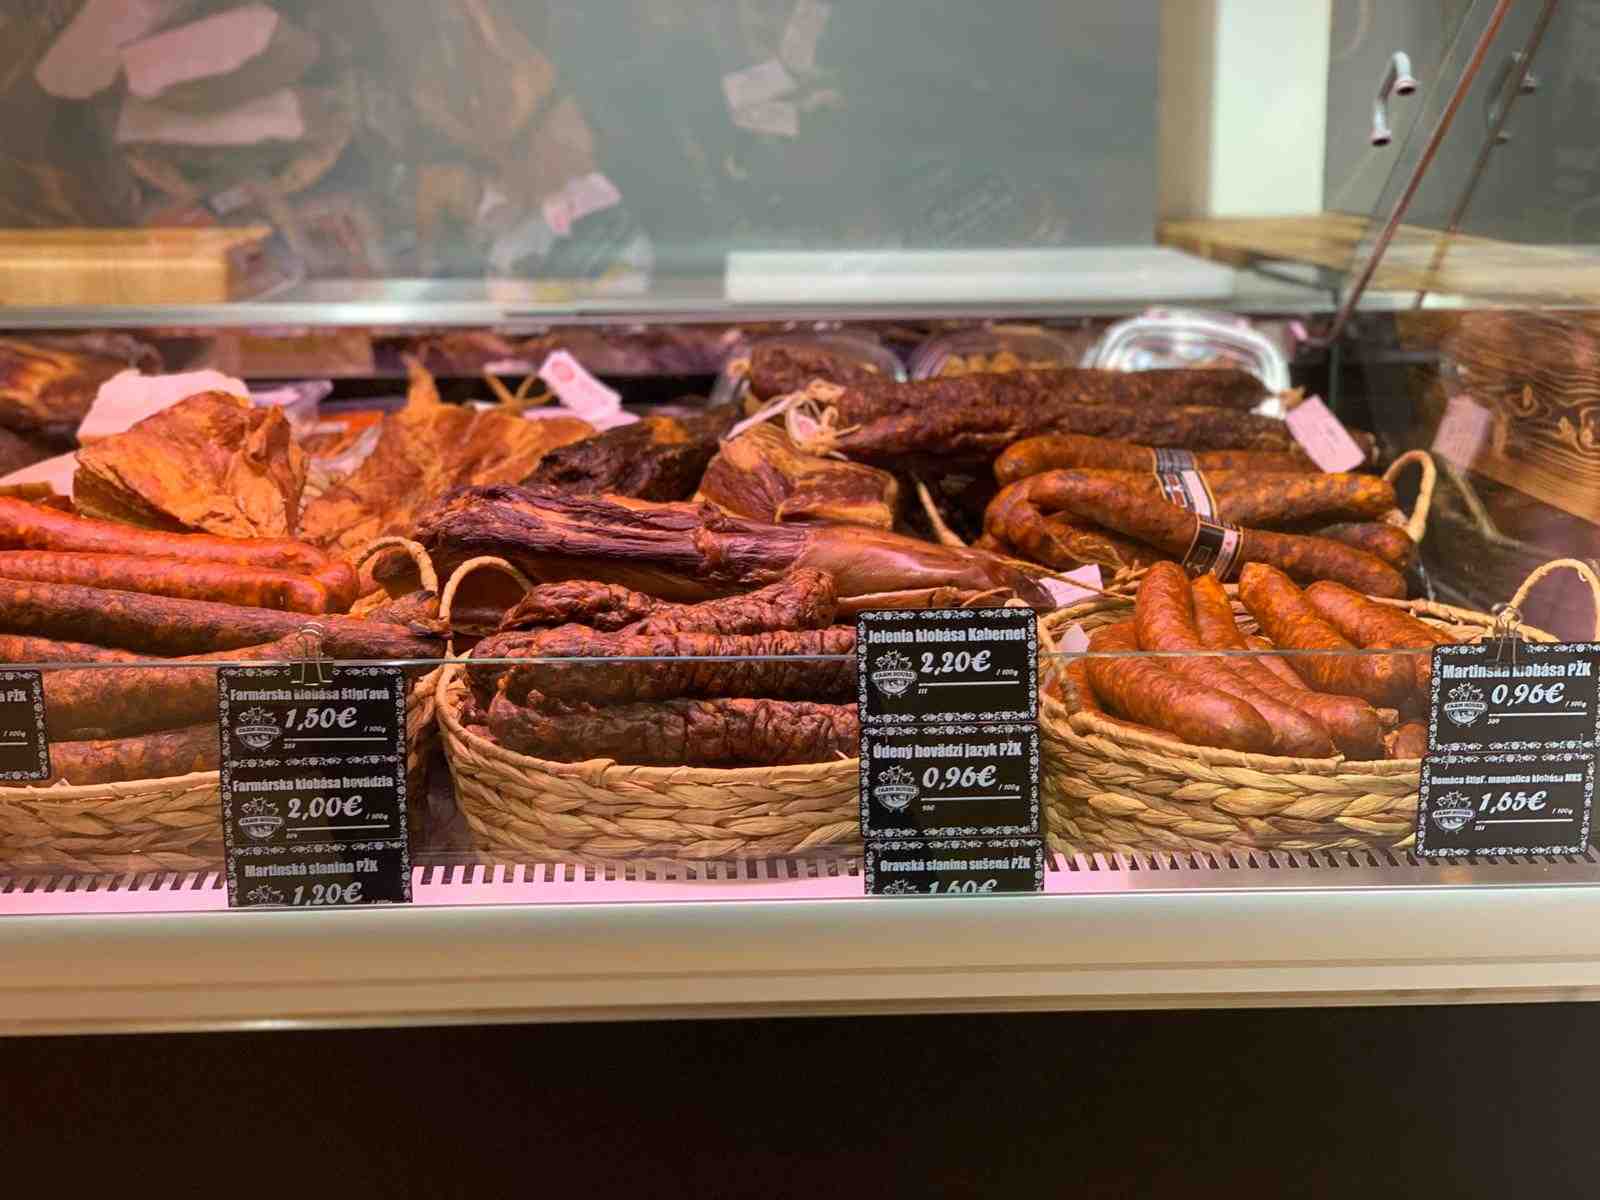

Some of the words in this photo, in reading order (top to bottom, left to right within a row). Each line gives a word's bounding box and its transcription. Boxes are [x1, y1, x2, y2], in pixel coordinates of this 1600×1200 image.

[868, 629, 914, 643] Jelenia
[915, 628, 966, 642] klobása
[968, 627, 1025, 642] Kabernet
[920, 650, 991, 676] 2,20€
[1567, 660, 1592, 677] PŽK
[230, 689, 292, 701] Farmárska
[293, 688, 339, 701] klobása
[1491, 682, 1565, 706] 0,96€
[285, 707, 357, 731] 1,50€
[873, 743, 913, 759] Údený
[965, 743, 998, 758] jazyk
[999, 741, 1022, 756] PŽK
[233, 779, 294, 792] Farmárska
[295, 777, 341, 790] klobása
[922, 765, 997, 790] 0,96€
[288, 795, 363, 821] 2,00€
[1479, 791, 1547, 814] 1,65€
[309, 862, 354, 875] slanina
[356, 858, 378, 872] PŽK
[880, 859, 924, 872] Oravská
[926, 859, 967, 871] slanina
[1011, 855, 1031, 869] PŽK
[292, 882, 363, 906] 1,20€
